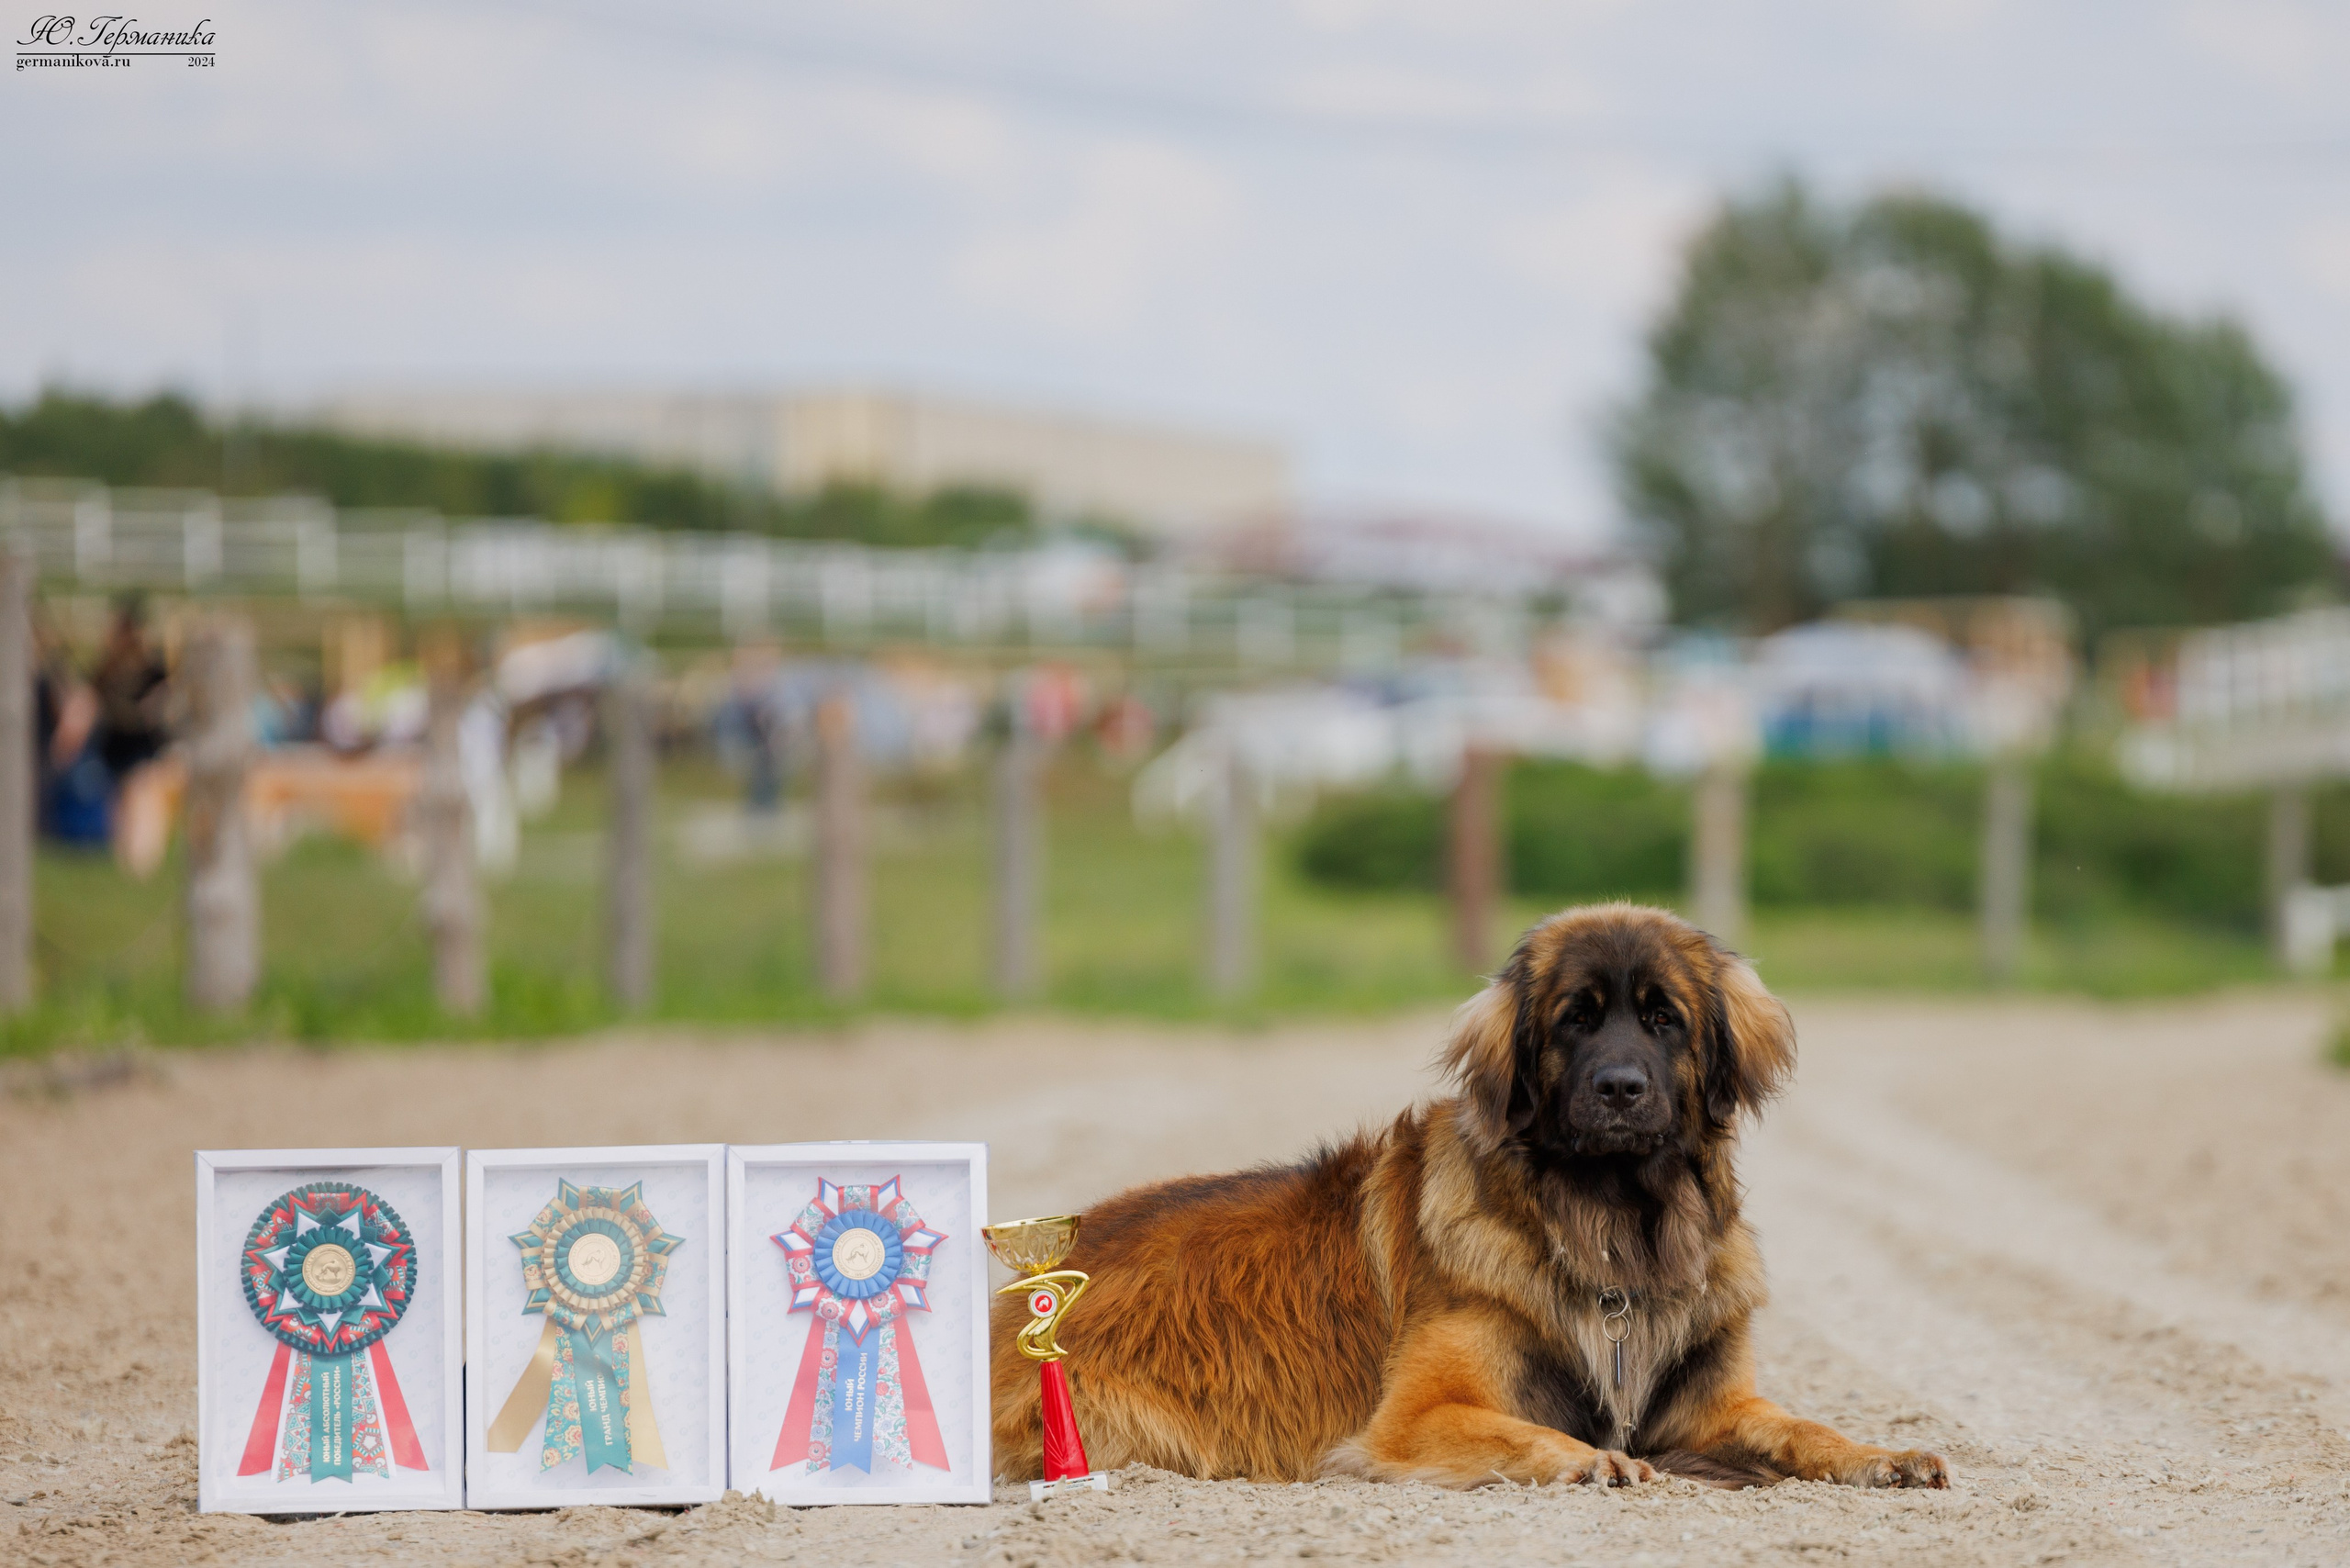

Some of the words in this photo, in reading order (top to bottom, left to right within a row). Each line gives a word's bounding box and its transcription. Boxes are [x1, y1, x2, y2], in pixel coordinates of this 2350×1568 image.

[857, 1352, 868, 1391] РОССИИ
[321, 1372, 330, 1434] АБСОЛЮТНЫЙ
[585, 1380, 598, 1412] ЮНЫЙ
[845, 1378, 855, 1412] ЮНЫЙ
[601, 1413, 613, 1446] ГРАНД
[854, 1392, 865, 1442] ЧЕМПИОН
[321, 1435, 330, 1463] ЮНЫЙ
[333, 1411, 342, 1466] ПОБЕДИТЕЛЬ
